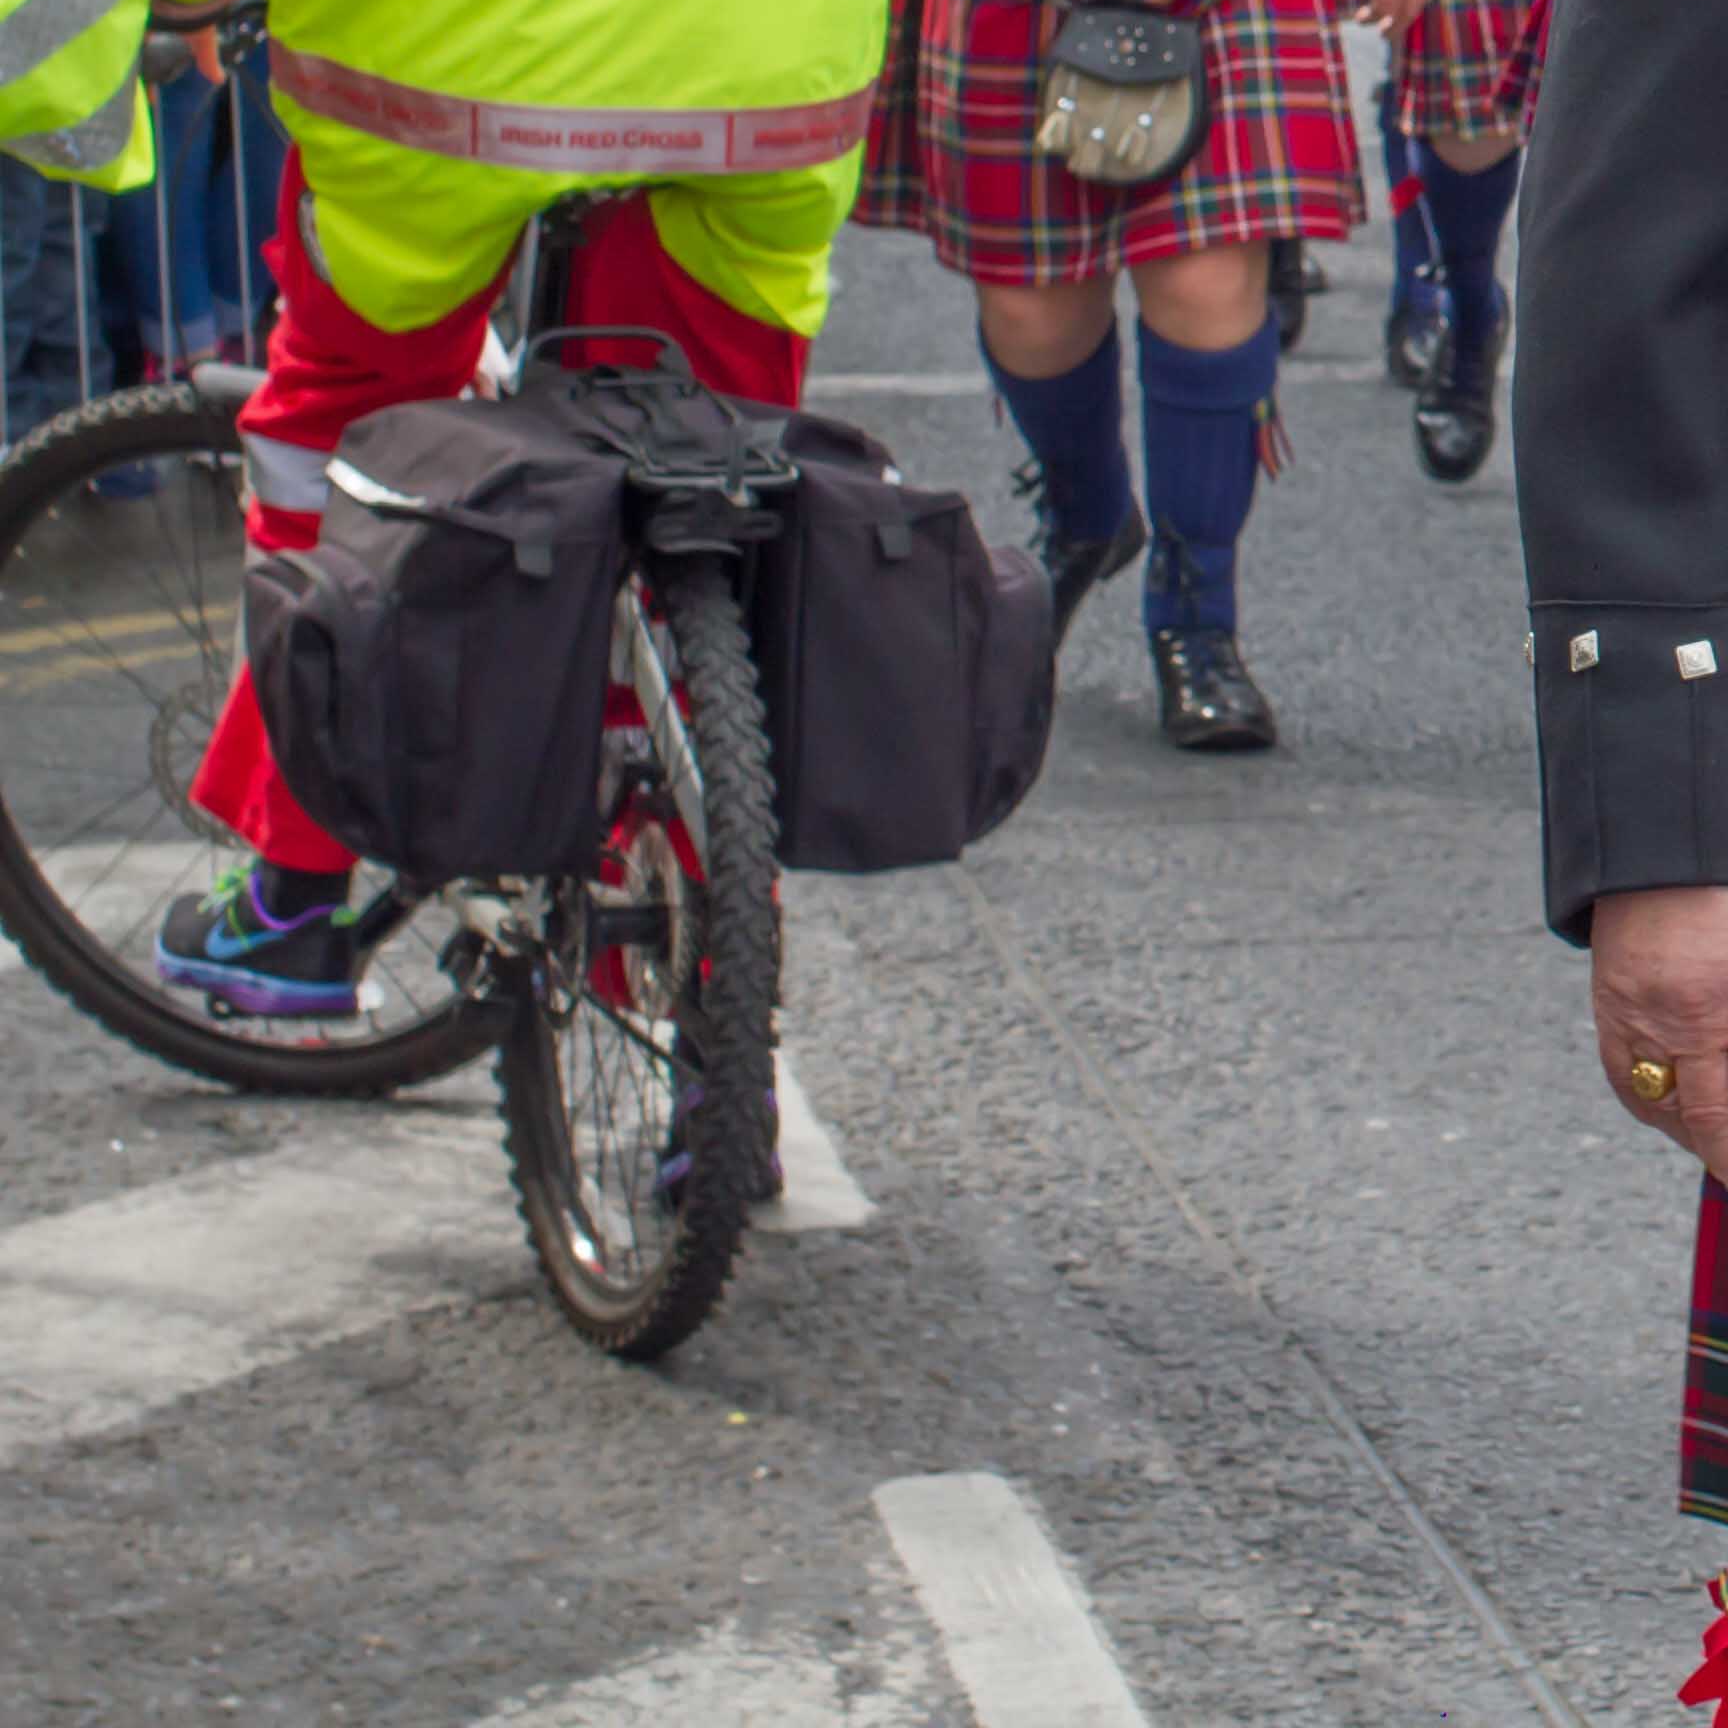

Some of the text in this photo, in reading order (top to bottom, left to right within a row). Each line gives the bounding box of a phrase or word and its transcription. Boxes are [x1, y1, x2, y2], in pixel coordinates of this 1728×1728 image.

[500, 126, 704, 151] IRISH RED CROSS
